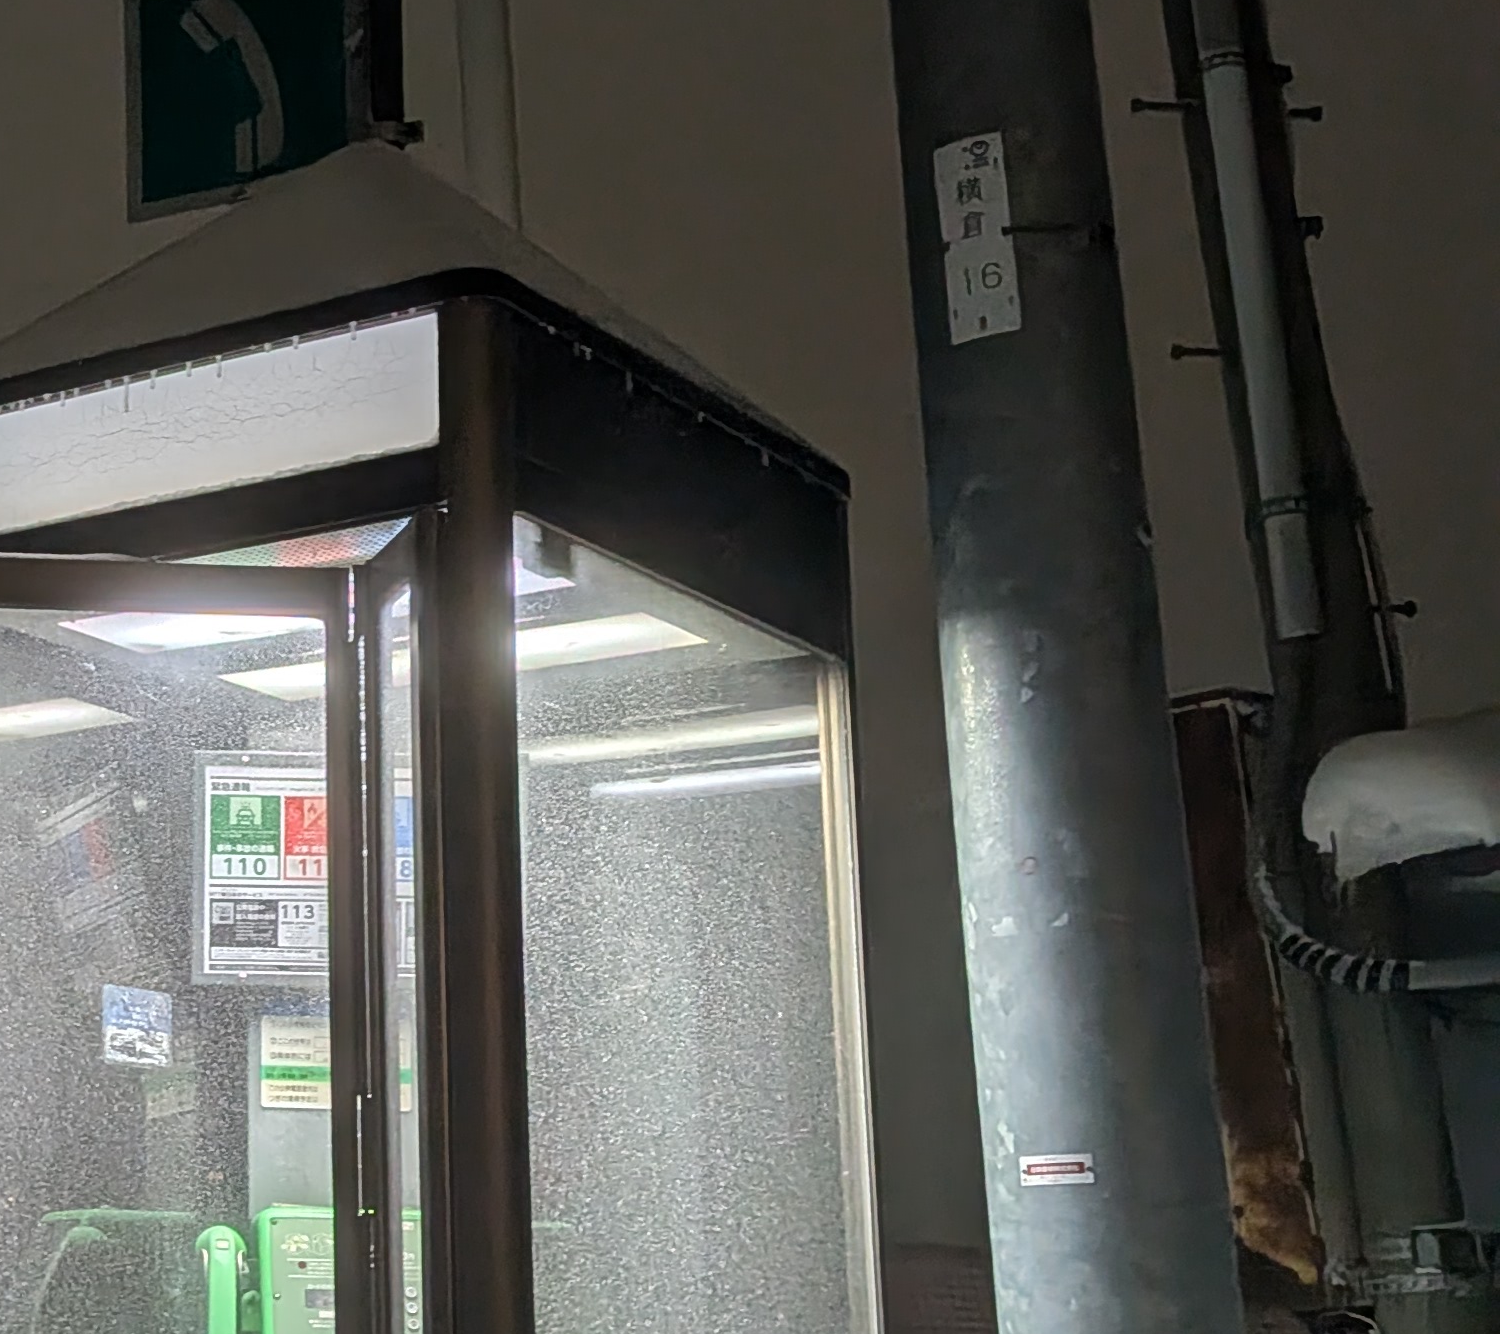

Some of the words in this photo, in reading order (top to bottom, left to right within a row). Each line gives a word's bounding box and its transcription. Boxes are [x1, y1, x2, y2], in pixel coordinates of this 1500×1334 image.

[963, 261, 1004, 296] 16
[223, 857, 267, 875] 110
[298, 858, 324, 876] 11
[281, 904, 315, 920] 113
